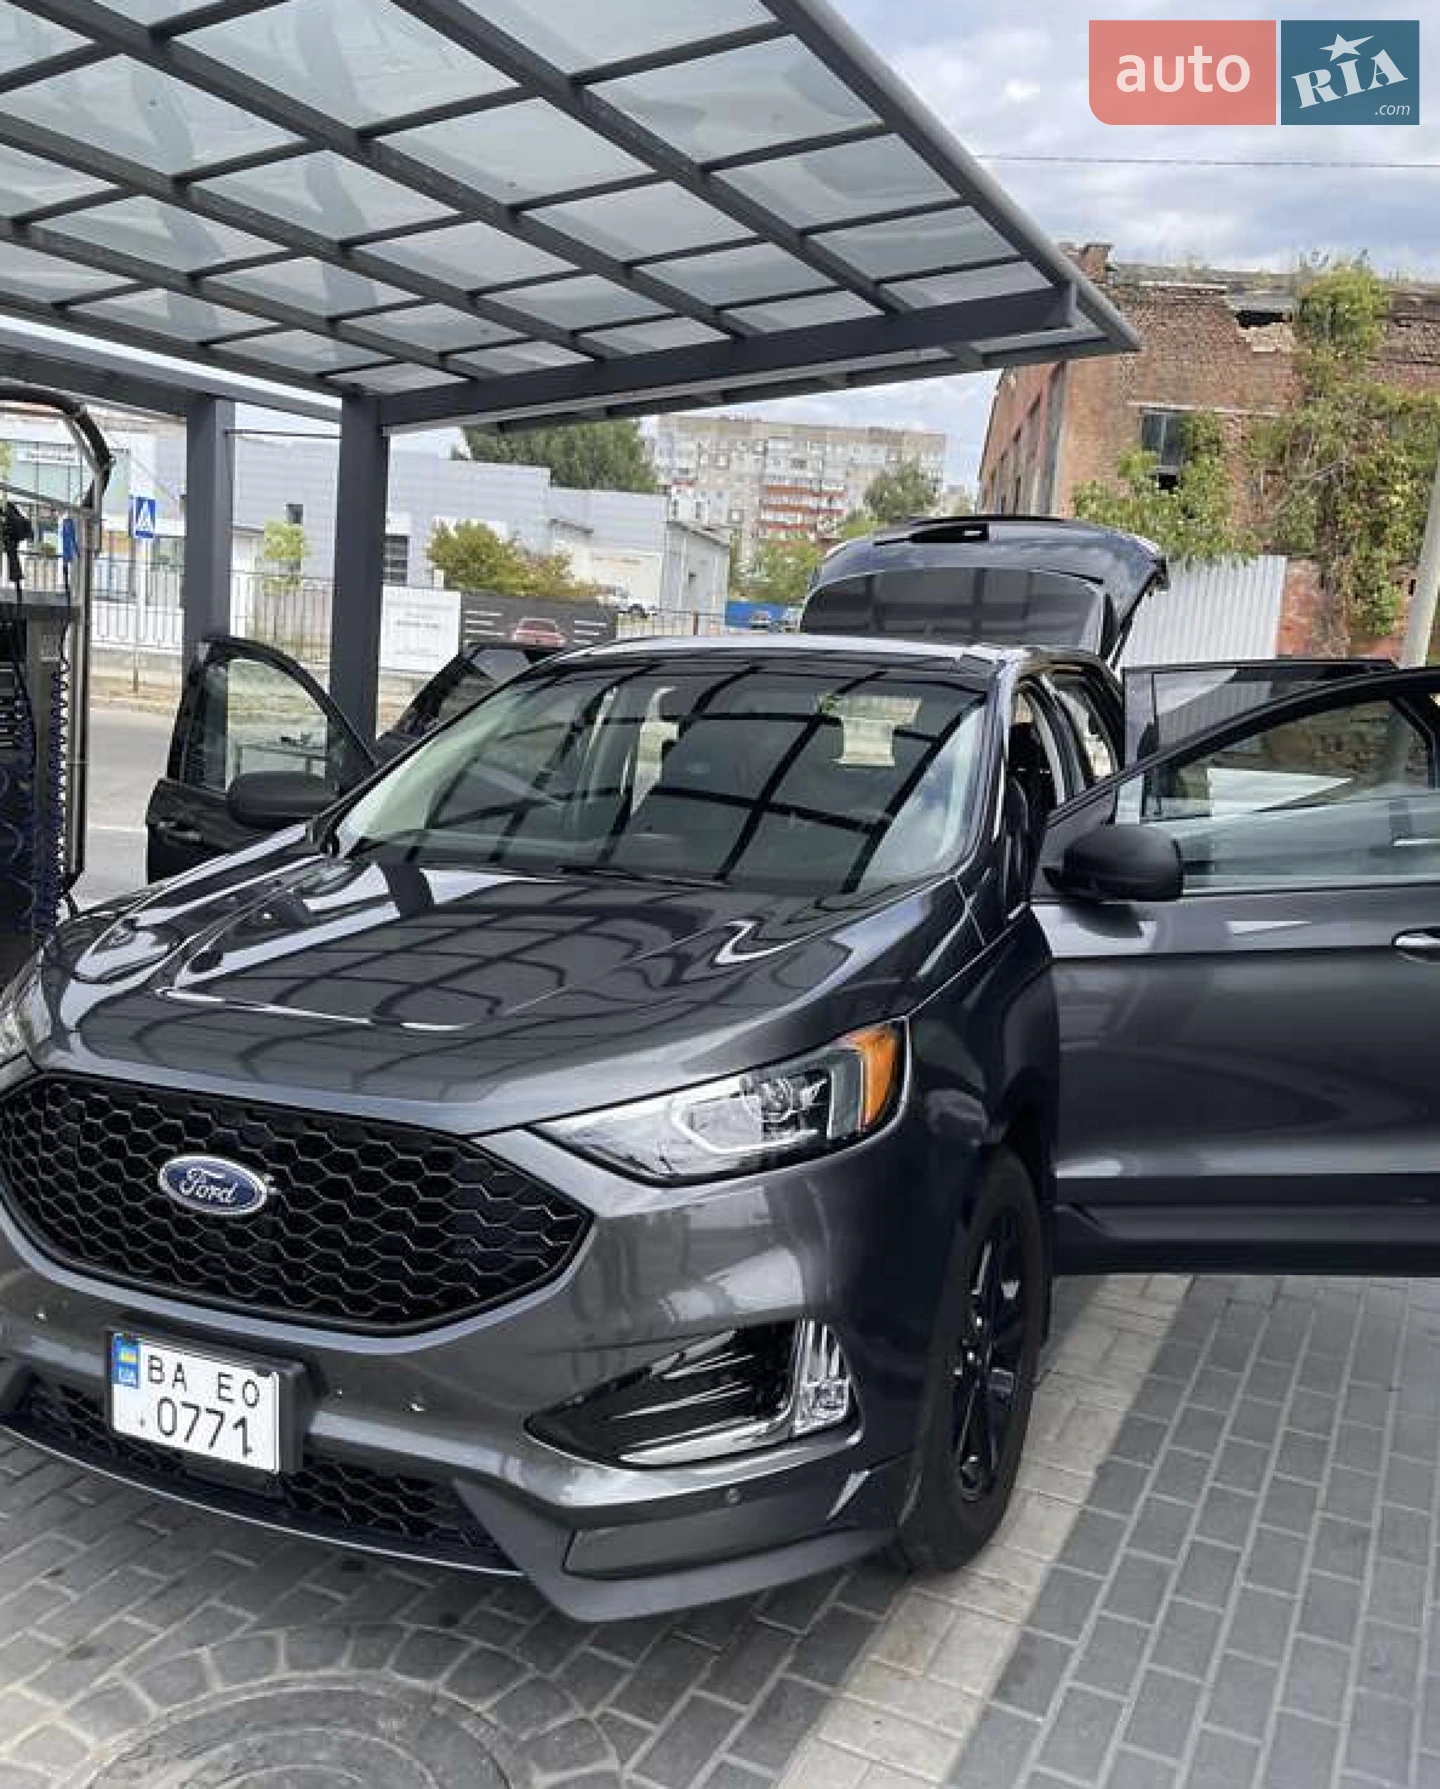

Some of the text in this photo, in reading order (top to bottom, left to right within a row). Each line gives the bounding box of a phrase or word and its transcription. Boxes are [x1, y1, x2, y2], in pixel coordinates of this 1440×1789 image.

[180, 1167, 239, 1203] Ford
[147, 1354, 188, 1392] BA
[157, 1396, 249, 1457] 0771
